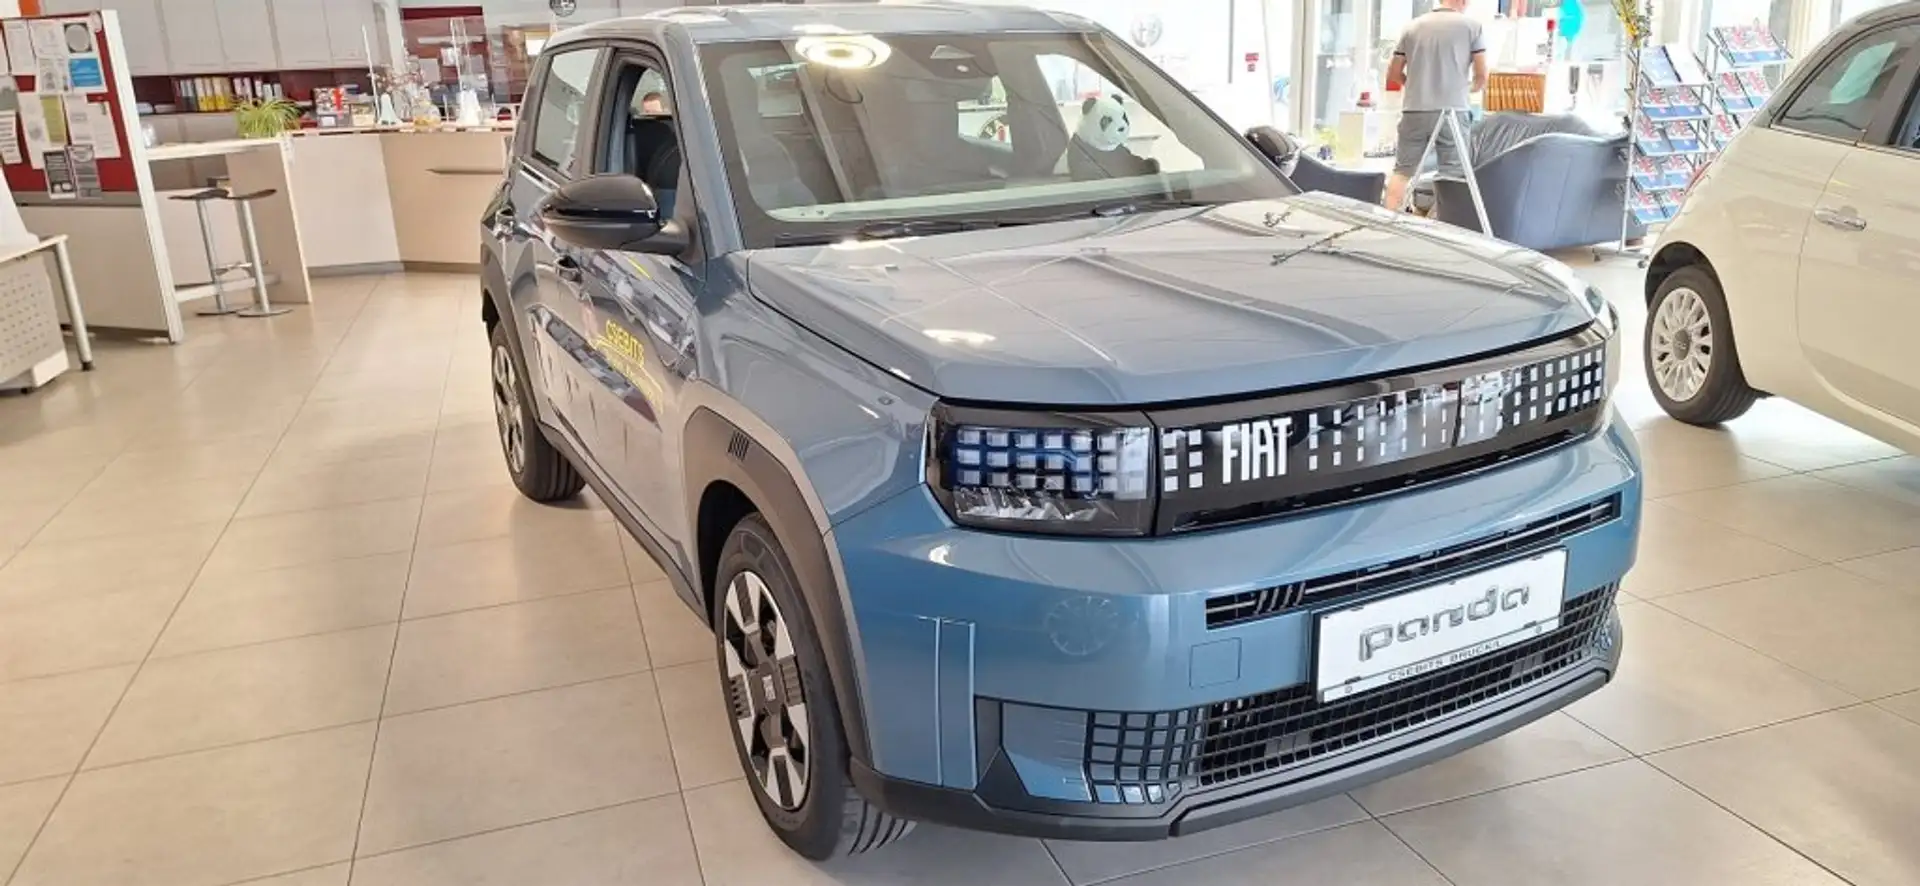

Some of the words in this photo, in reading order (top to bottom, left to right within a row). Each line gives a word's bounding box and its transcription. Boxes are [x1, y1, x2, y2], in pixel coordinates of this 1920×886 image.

[1221, 416, 1293, 485] FIAT
[1358, 584, 1531, 662] panda
[1387, 660, 1444, 681] CSEBITS
